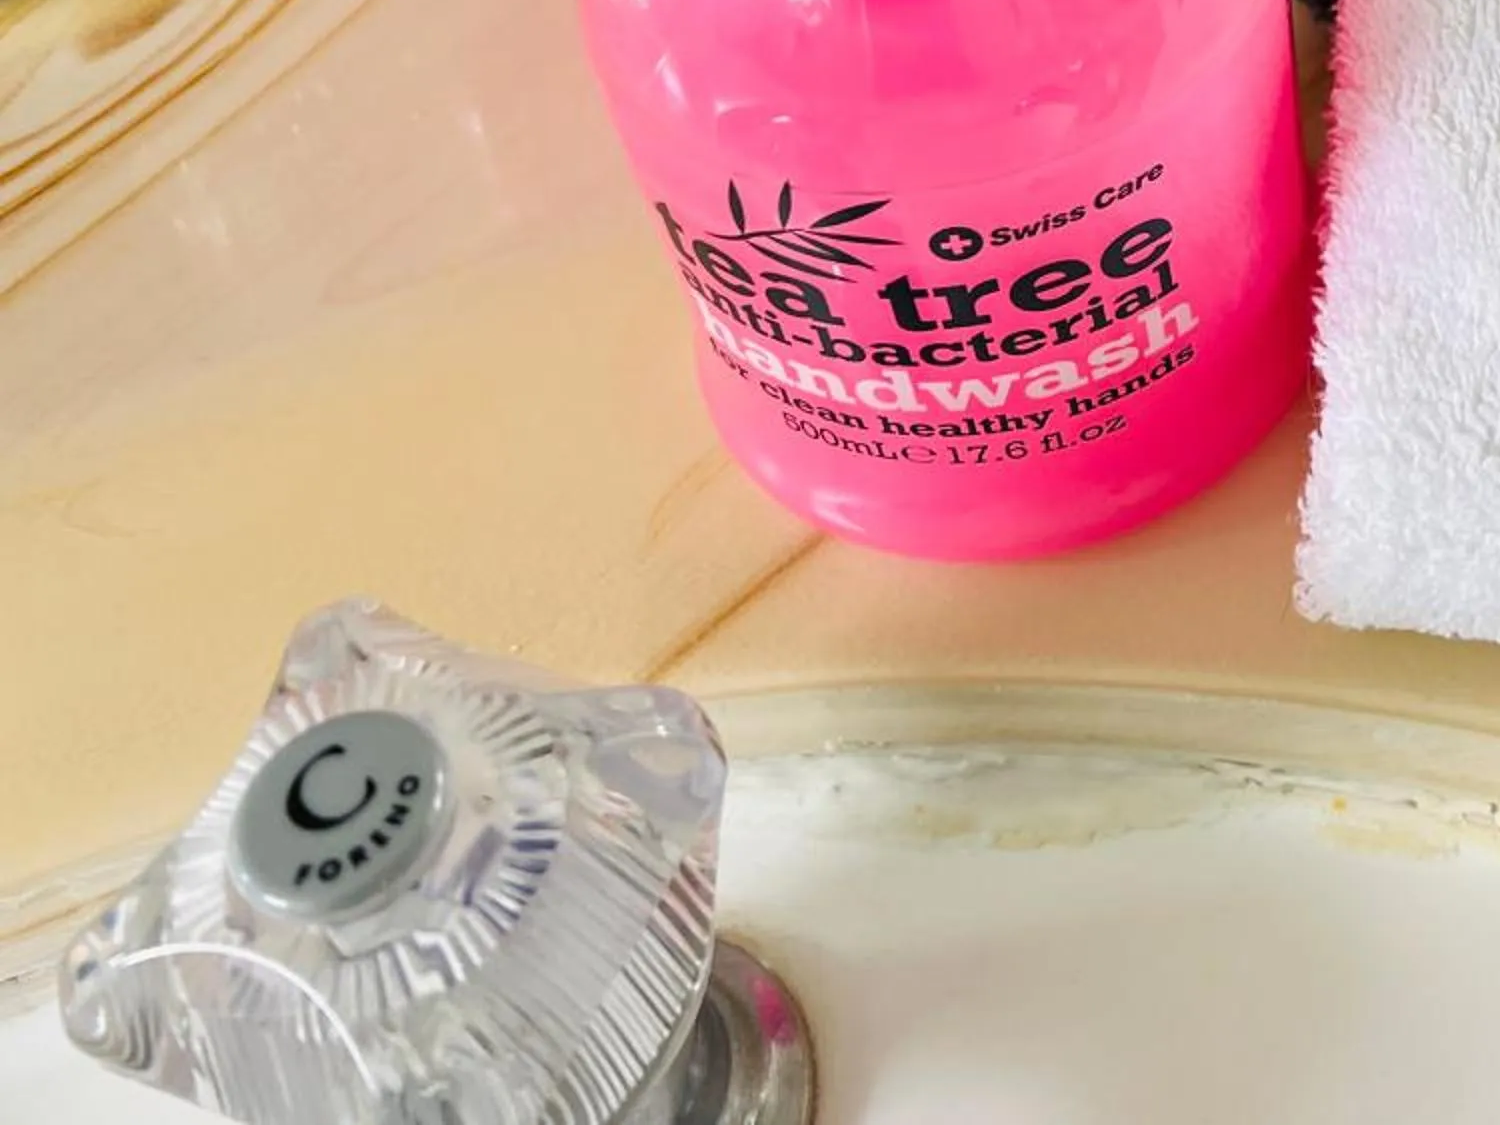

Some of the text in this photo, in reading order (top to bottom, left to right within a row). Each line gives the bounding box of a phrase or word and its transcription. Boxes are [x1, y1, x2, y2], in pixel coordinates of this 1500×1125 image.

[990, 163, 1164, 246] Swiss Care
[655, 201, 1173, 332] tea tree
[679, 259, 1179, 367] anti-bacterial
[688, 288, 1200, 412] handwash
[760, 380, 868, 430] clean
[877, 408, 1054, 438] healthy
[1065, 345, 1195, 418] hands
[946, 439, 1029, 465] 17.6
[285, 743, 377, 832] C
